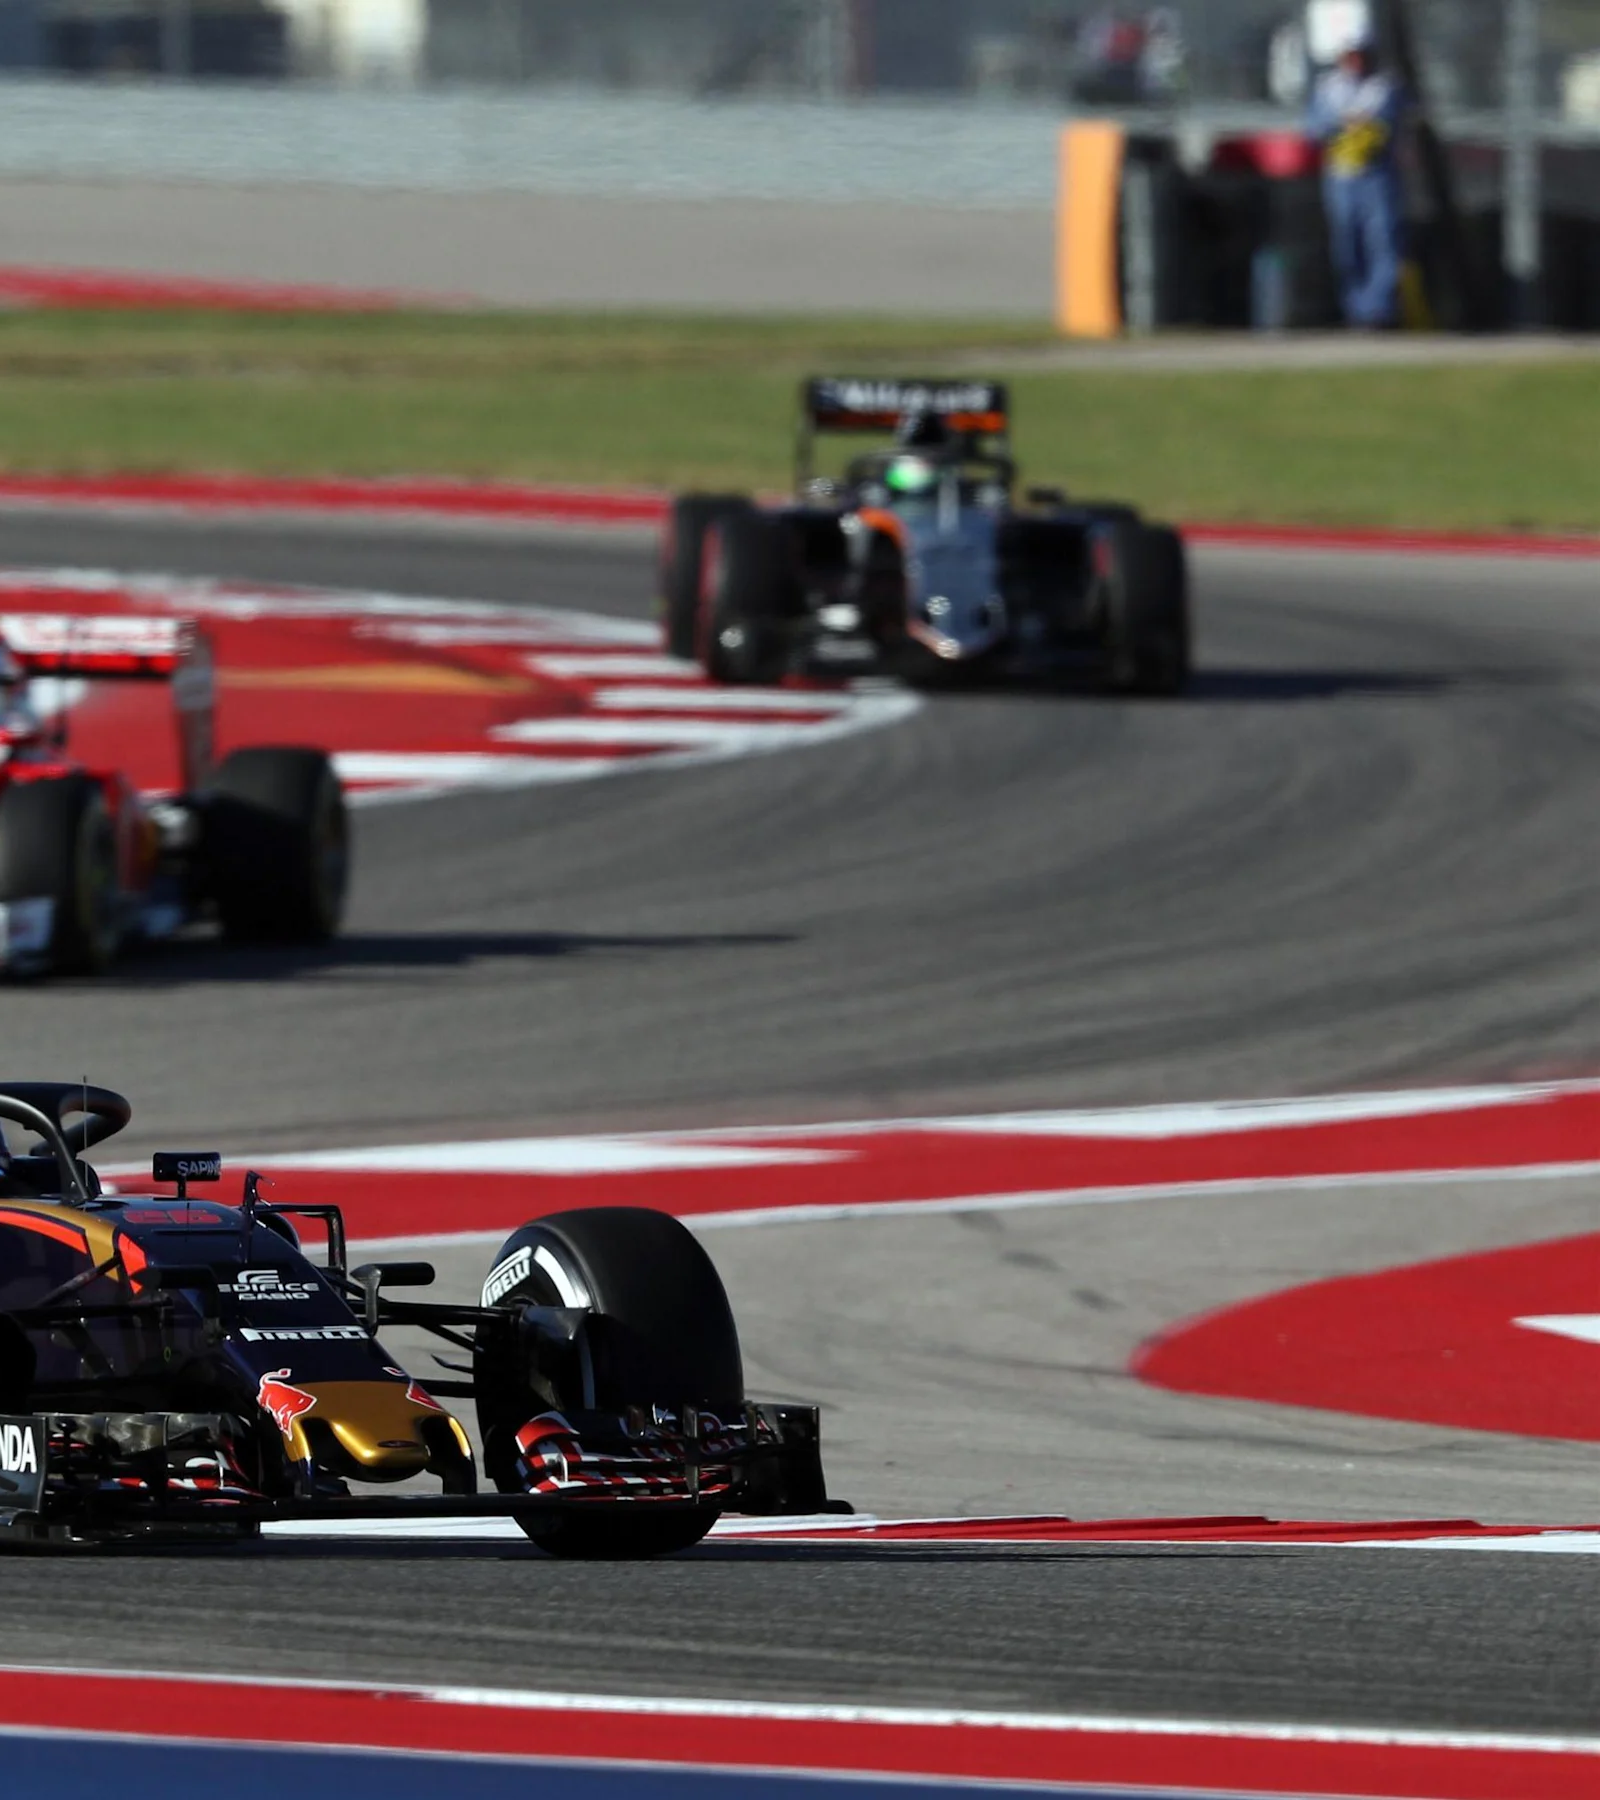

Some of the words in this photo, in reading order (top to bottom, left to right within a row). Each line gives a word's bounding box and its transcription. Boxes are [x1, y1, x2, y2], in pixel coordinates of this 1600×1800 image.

[217, 1283, 320, 1292] EDIFICE
[238, 1292, 310, 1301] CASIO
[239, 1325, 370, 1341] PIRELLI
